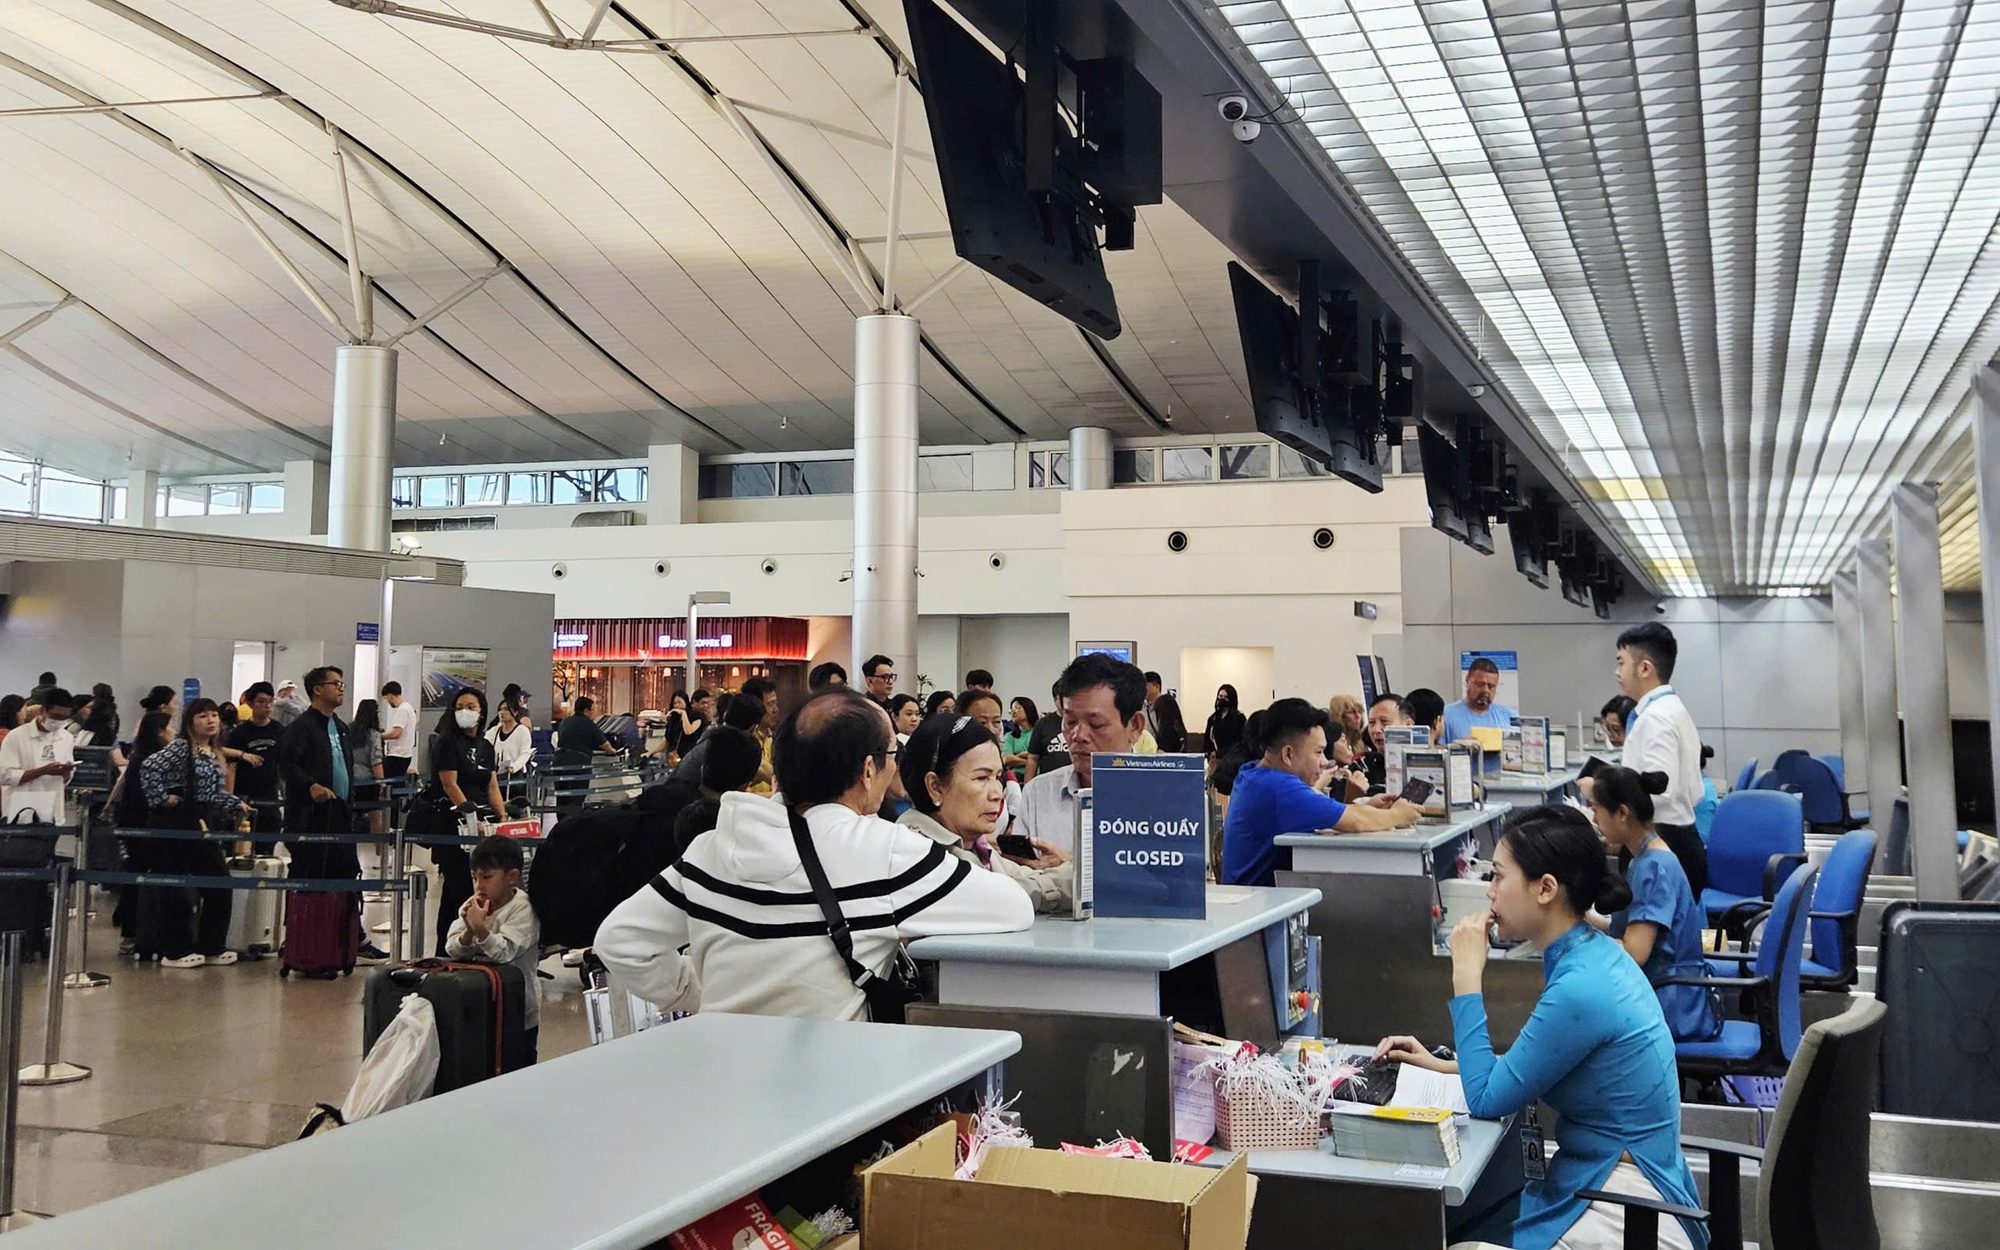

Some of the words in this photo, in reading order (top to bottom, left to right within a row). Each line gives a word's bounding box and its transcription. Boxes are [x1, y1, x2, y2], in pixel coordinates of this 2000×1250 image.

[1099, 818, 1149, 835] ĐÓNG
[1153, 818, 1199, 837] QUẦY
[1115, 850, 1184, 866] CLOSED
